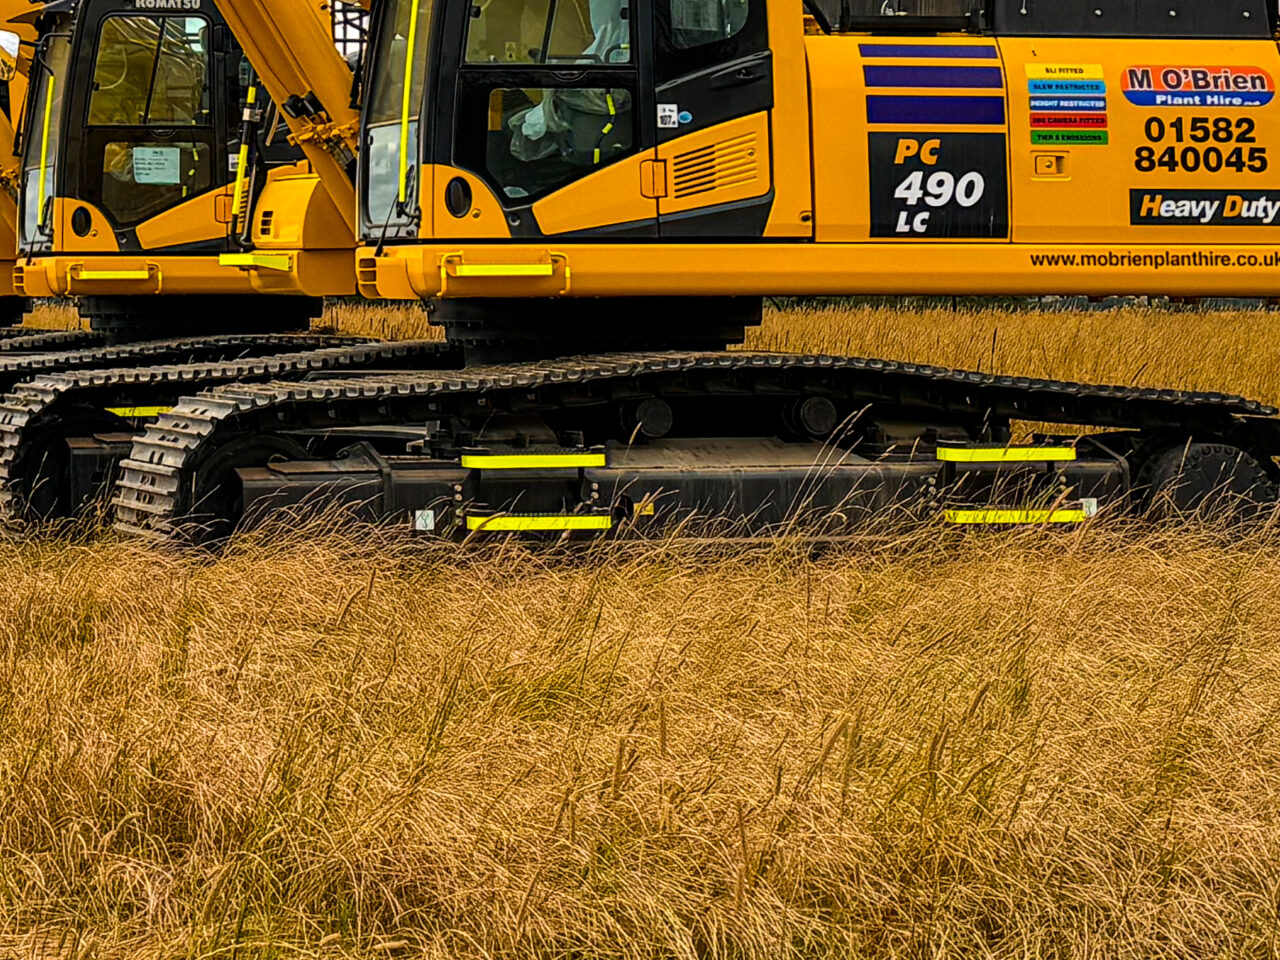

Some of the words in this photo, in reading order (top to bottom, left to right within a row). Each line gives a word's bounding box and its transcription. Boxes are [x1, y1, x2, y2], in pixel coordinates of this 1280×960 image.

[1127, 68, 1152, 90] M
[1162, 68, 1268, 91] O'Brien
[1155, 95, 1201, 105] Plant
[1206, 94, 1242, 105] Hire
[1144, 116, 1256, 143] 01582
[894, 139, 940, 165] PC
[1134, 146, 1268, 173] 840045
[894, 171, 985, 207] 490
[895, 211, 930, 233] LC
[1140, 194, 1220, 224] Heavy
[1223, 195, 1280, 224] Duty
[1030, 251, 1280, 270] www.mobrienplanthire.co.uk
